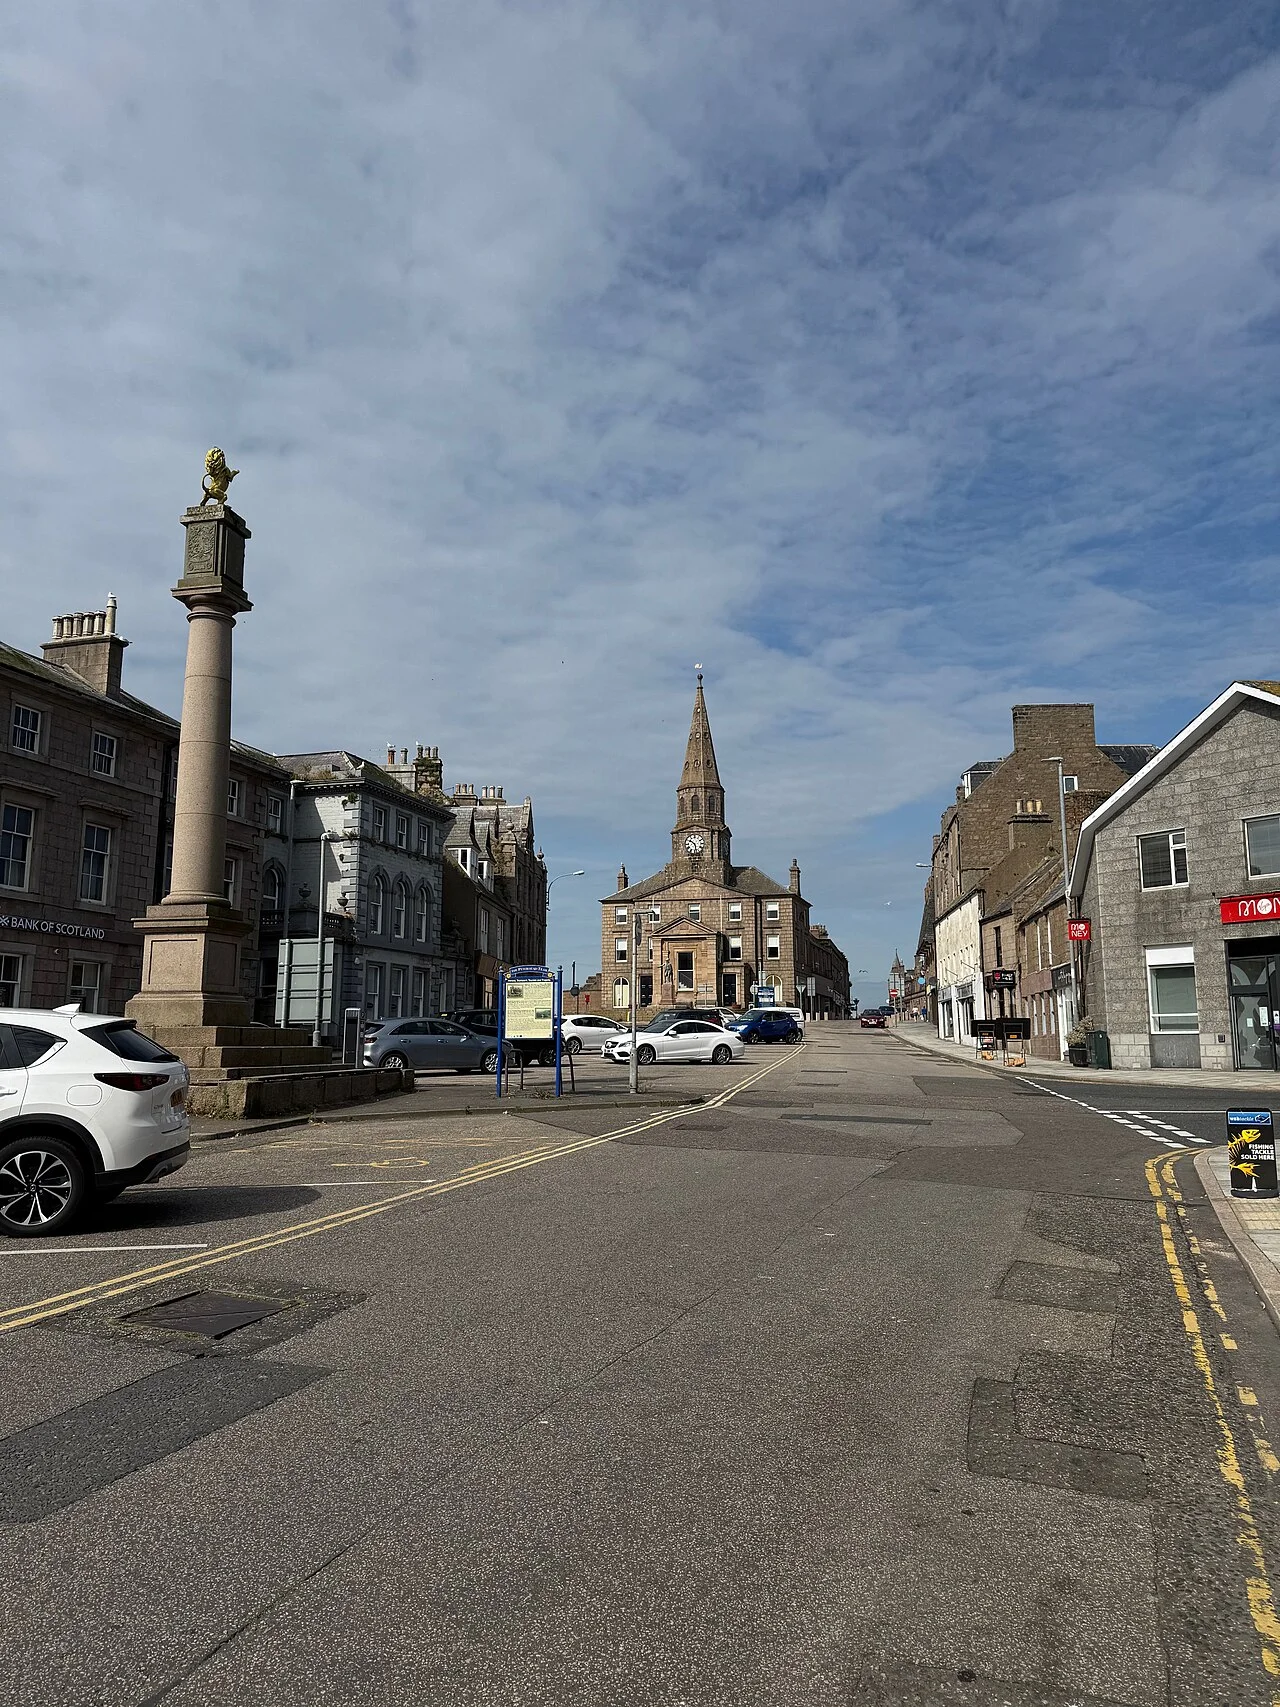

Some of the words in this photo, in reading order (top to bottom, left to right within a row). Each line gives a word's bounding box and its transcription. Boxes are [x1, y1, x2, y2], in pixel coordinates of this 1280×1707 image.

[11, 917, 39, 930] BANK
[40, 921, 54, 932] OF
[55, 923, 105, 939] SCOTLAND
